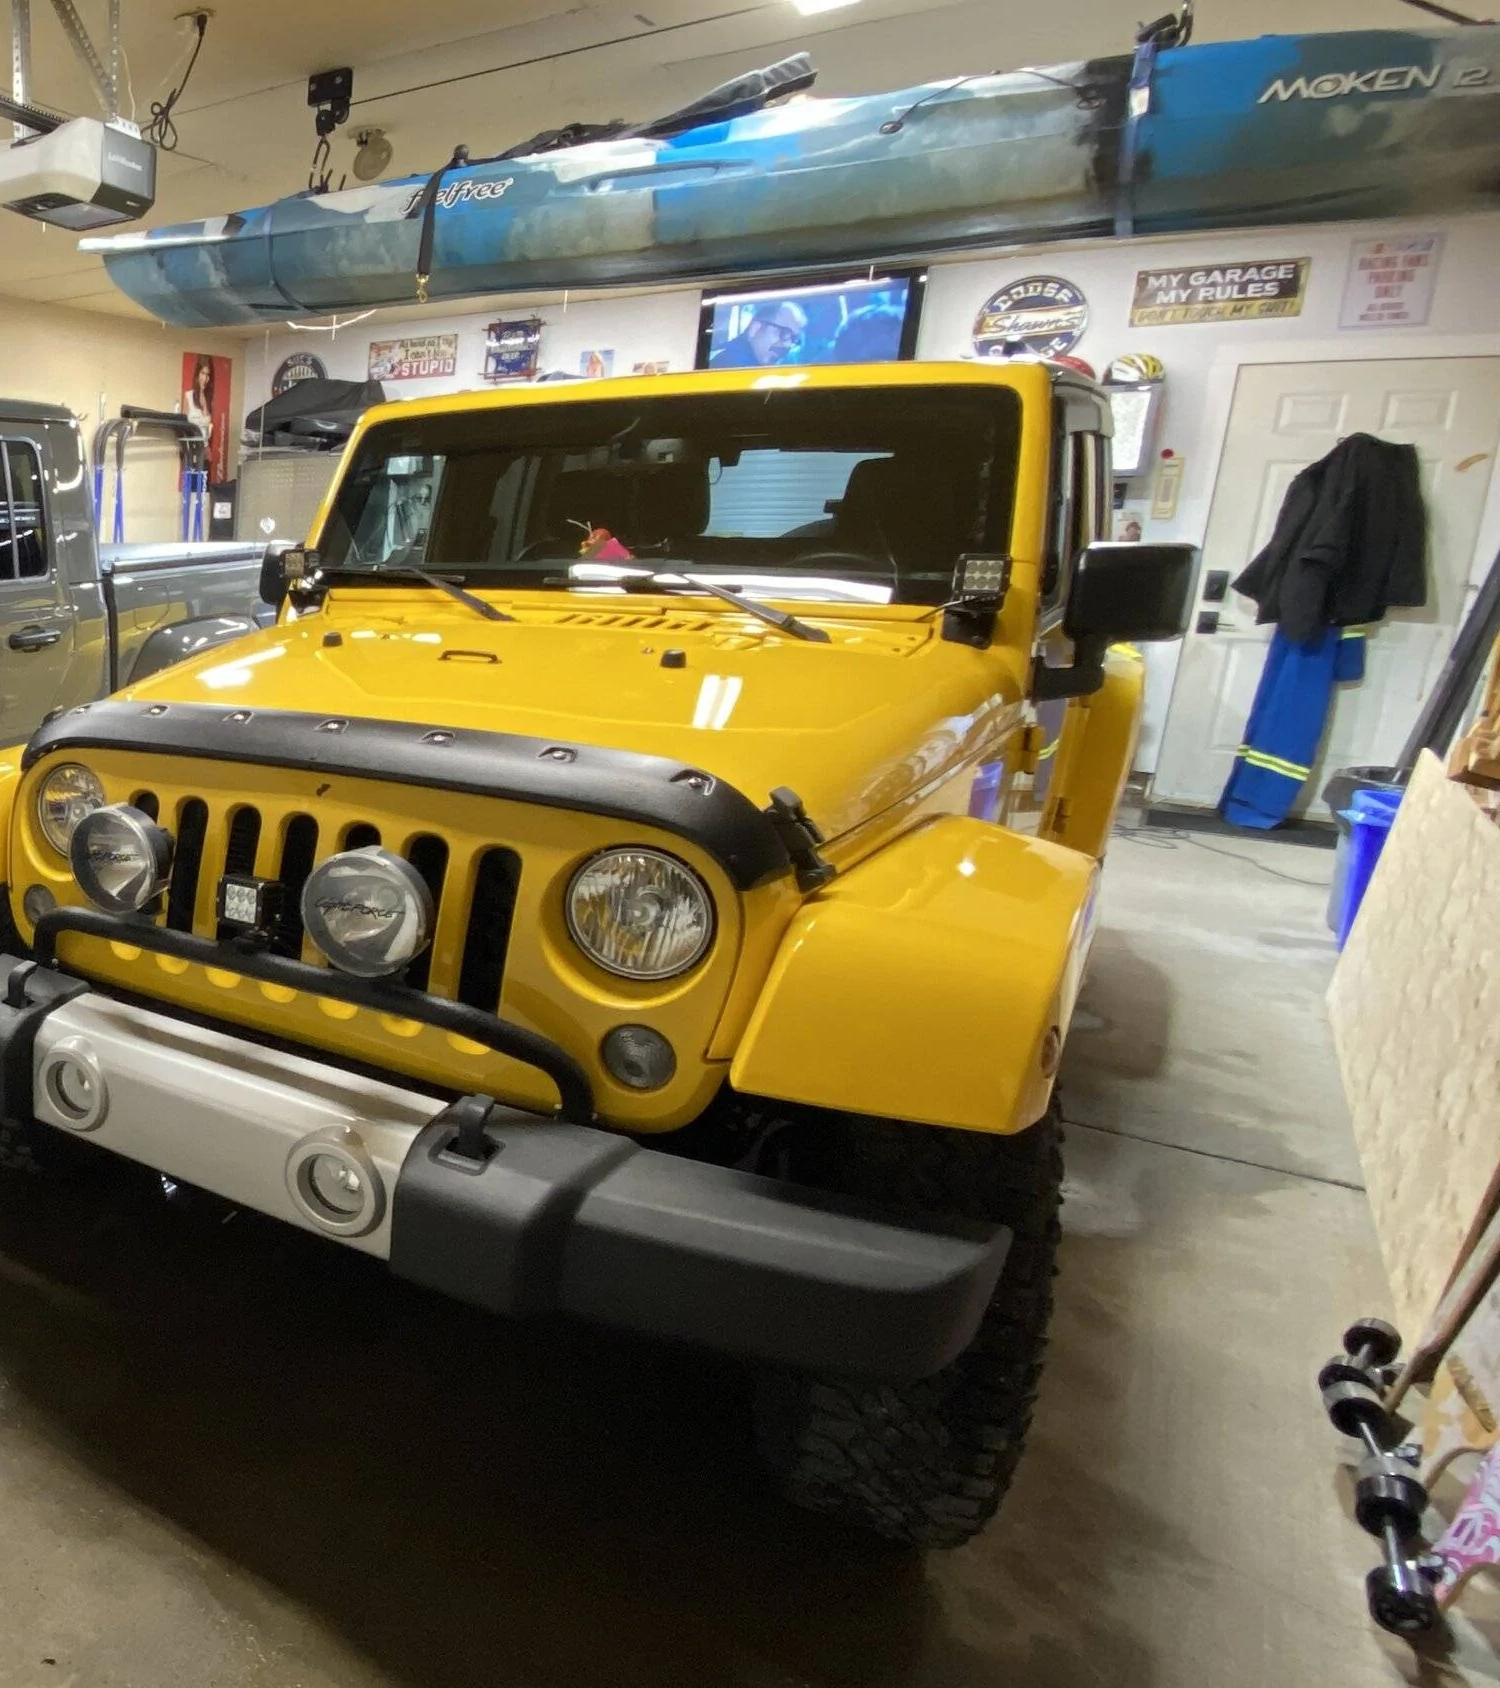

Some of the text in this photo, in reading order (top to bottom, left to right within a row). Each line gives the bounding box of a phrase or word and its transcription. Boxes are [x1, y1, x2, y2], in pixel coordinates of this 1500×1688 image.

[1257, 63, 1442, 104] MOKEN
[401, 178, 514, 214] felfree
[1148, 264, 1296, 290] MY GARAGE
[992, 281, 1074, 312] DODGE
[1155, 281, 1281, 305] MY RULES
[401, 358, 454, 376] STUPID
